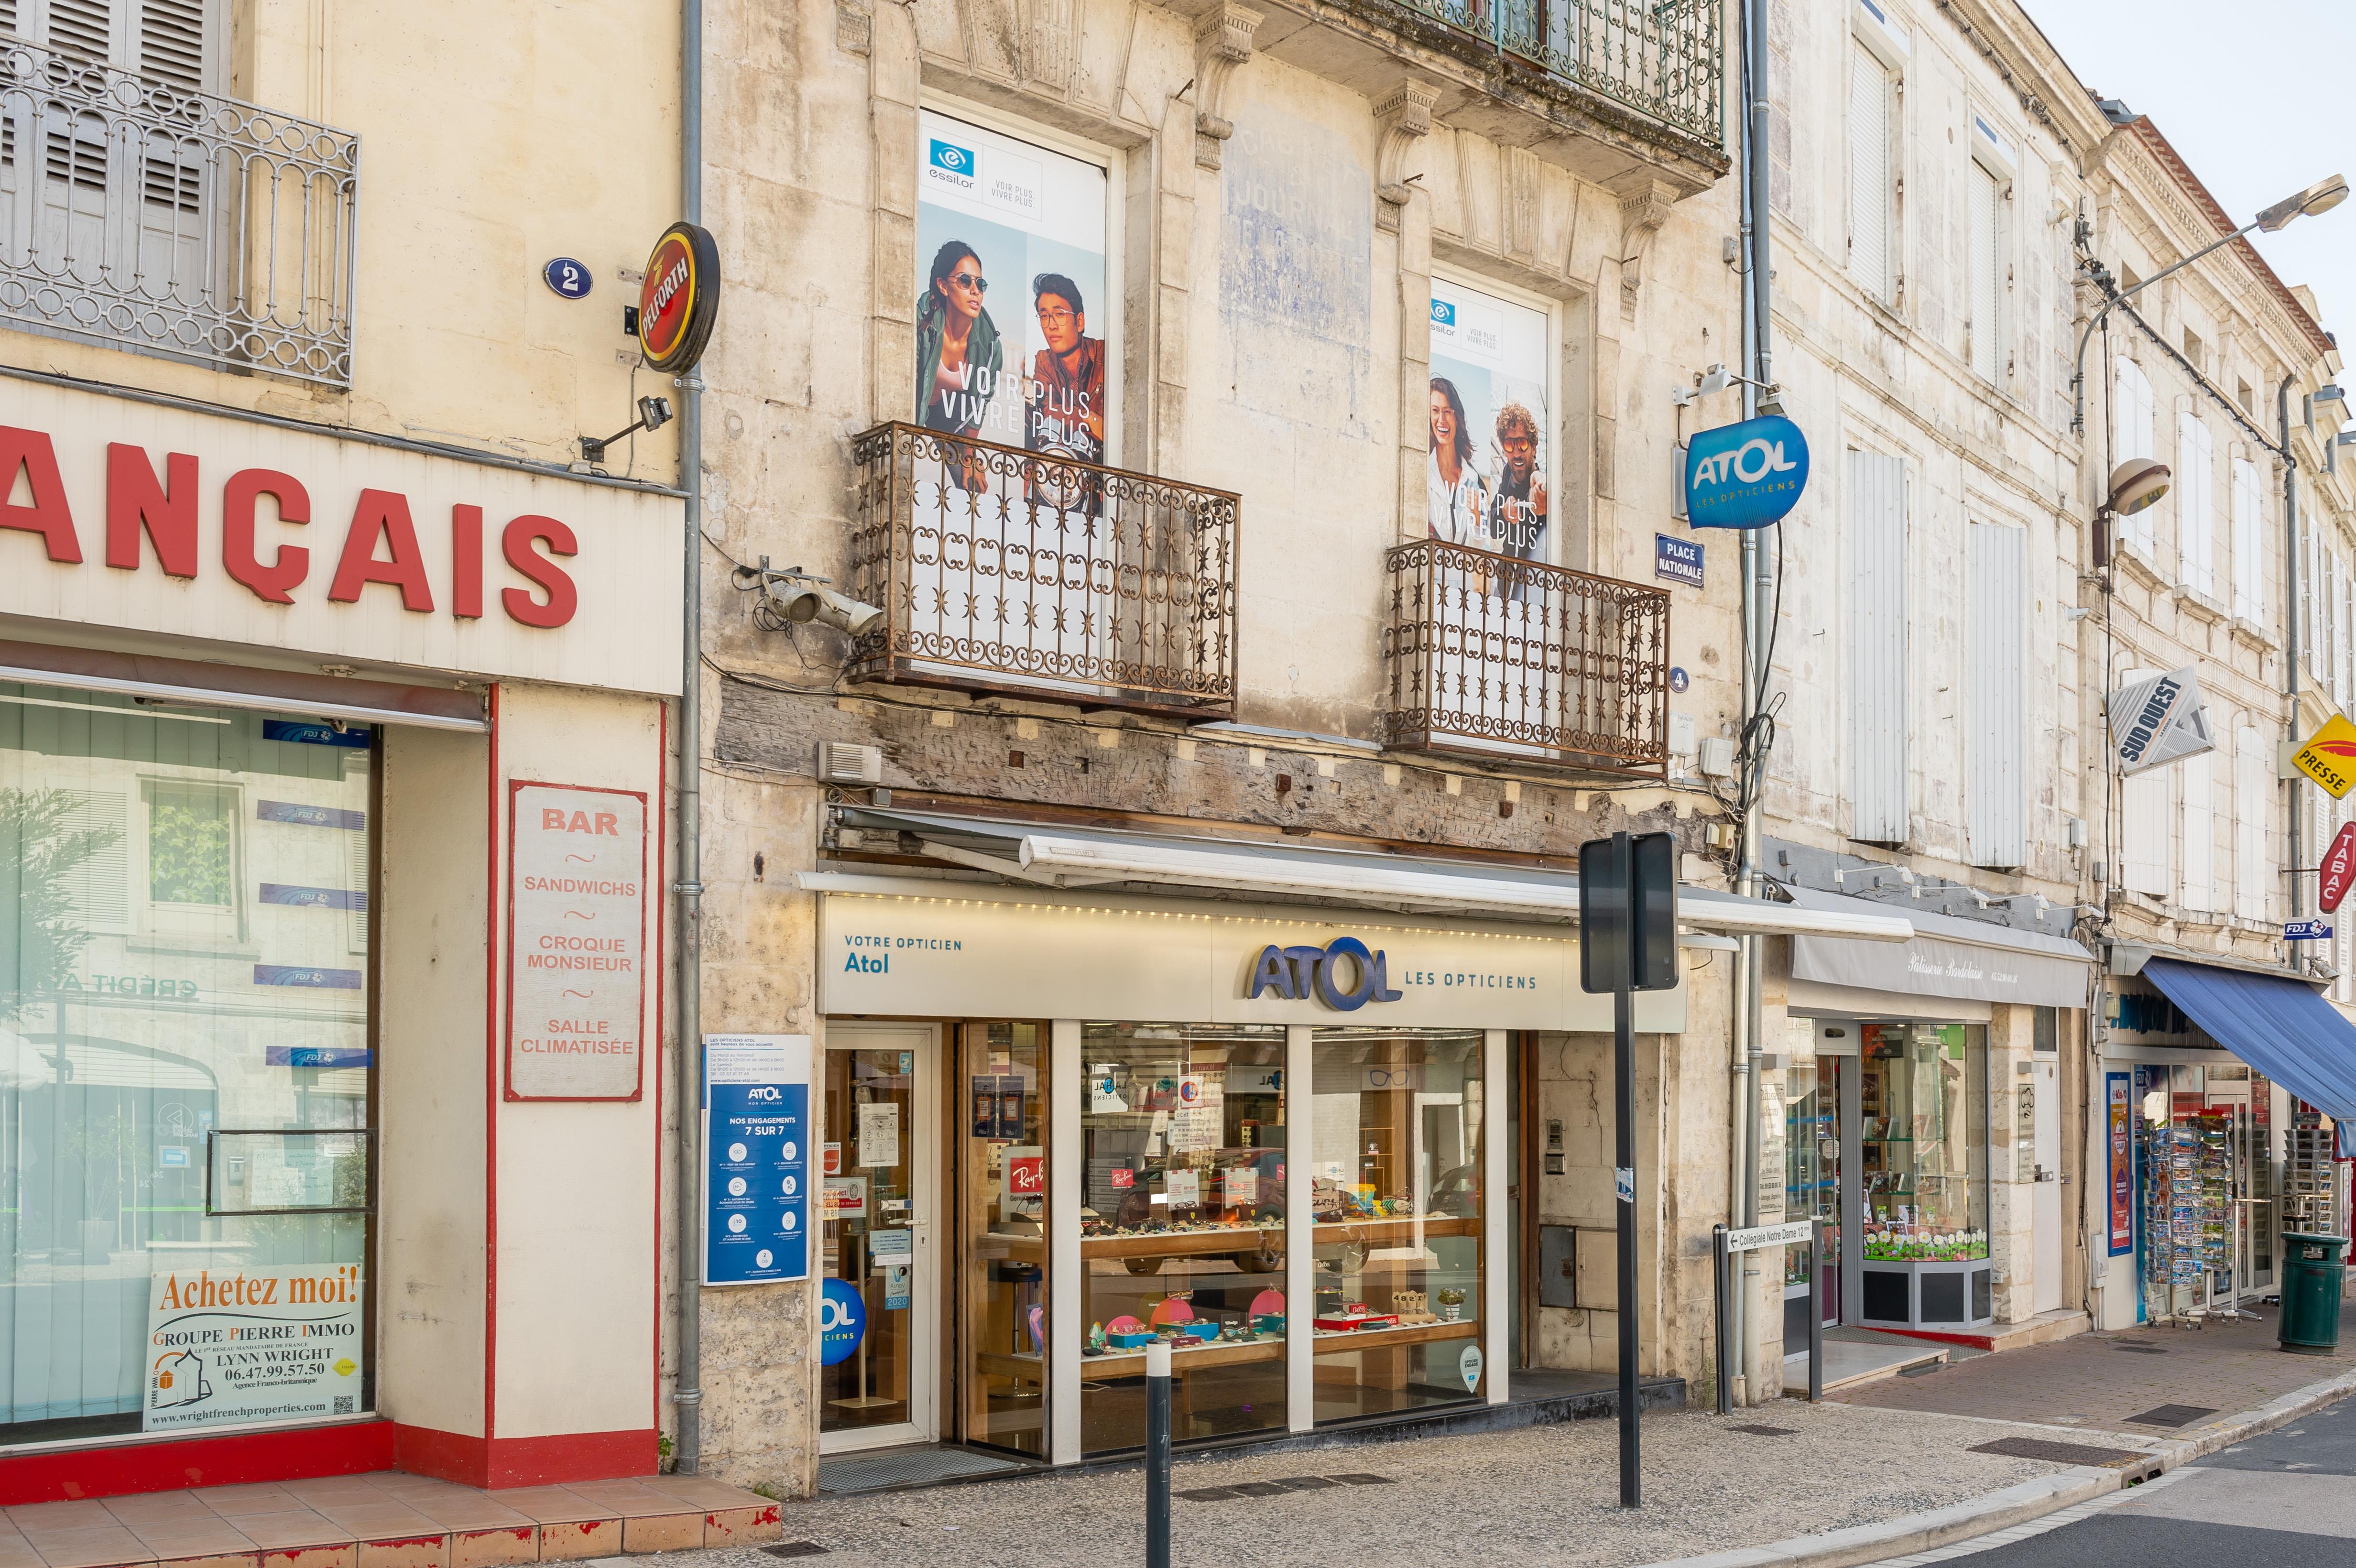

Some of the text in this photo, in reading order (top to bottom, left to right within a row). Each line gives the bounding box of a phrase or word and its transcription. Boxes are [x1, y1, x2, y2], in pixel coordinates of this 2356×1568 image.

[929, 169, 974, 190] essilor
[995, 179, 1035, 200] VOIR PLUS.
[992, 187, 1035, 208] VIVRE PLUS.
[562, 263, 578, 291] 2
[642, 257, 689, 340] PELFORTH
[1430, 324, 1455, 337] ssilor
[1467, 335, 1482, 345] VIVRE
[1470, 327, 1497, 343] VOIR PLUS.
[958, 360, 1097, 421] VOIR PLUS.
[941, 388, 1097, 452] VIVRE PLUS.
[1693, 438, 1797, 490] ATOL
[1444, 479, 1542, 526] VOIR PLUS.
[1696, 480, 1796, 509] LES OPTICIENS
[0, 425, 578, 629] ANÇAIS
[1433, 504, 1542, 551] VIVRE PLUS.
[1667, 543, 1696, 561] PLACE
[1658, 557, 1702, 580] NATIONALE
[1675, 673, 1684, 688] 4
[2120, 676, 2182, 763] SUD OUEST
[303, 729, 318, 739] FDJ
[2299, 750, 2346, 791] PRESSE
[297, 810, 313, 820] FDJ
[543, 808, 619, 836] BAR
[2323, 834, 2353, 900] TABAC
[524, 876, 636, 896] SANDWICHS
[299, 892, 316, 901] FDJ
[2286, 924, 2307, 933] FDJ
[539, 935, 625, 952] CROQUE
[844, 935, 961, 951] VOTRE OPTICIEN
[527, 954, 632, 972] MONSIEUR
[844, 952, 888, 974] Atol
[1908, 951, 1984, 980] Pâtisserie Bordelaise
[294, 972, 310, 981] FDJ
[1245, 936, 1403, 1012] ATOL
[1406, 970, 1536, 990] LES OPTICIENS
[548, 1019, 609, 1034] SALLE
[521, 1037, 633, 1055] CLIMATISÉE
[306, 1053, 322, 1062] FDJ
[2136, 1073, 2144, 1084] FDJ
[748, 1086, 782, 1101] ATOL
[745, 1126, 785, 1135] 7 SUR 7
[1013, 1160, 1043, 1188] Ray-
[1740, 1231, 1766, 1246] Collégiale
[1767, 1231, 1781, 1242] Notre
[1782, 1229, 1796, 1240] Dame
[158, 1265, 357, 1311] Achetez moi!
[888, 1297, 907, 1306] 2020
[822, 1297, 856, 1331] OL
[153, 1323, 355, 1347] GROUPE PIERRE IMMO
[822, 1332, 854, 1341] CIENS
[217, 1348, 334, 1367] LYNN WRIGHT
[225, 1362, 325, 1381] 06.47.99.57.50
[232, 1377, 317, 1390] Agence Franco-britannique
[152, 1403, 326, 1425] www.wrightfrenchproperties.com
